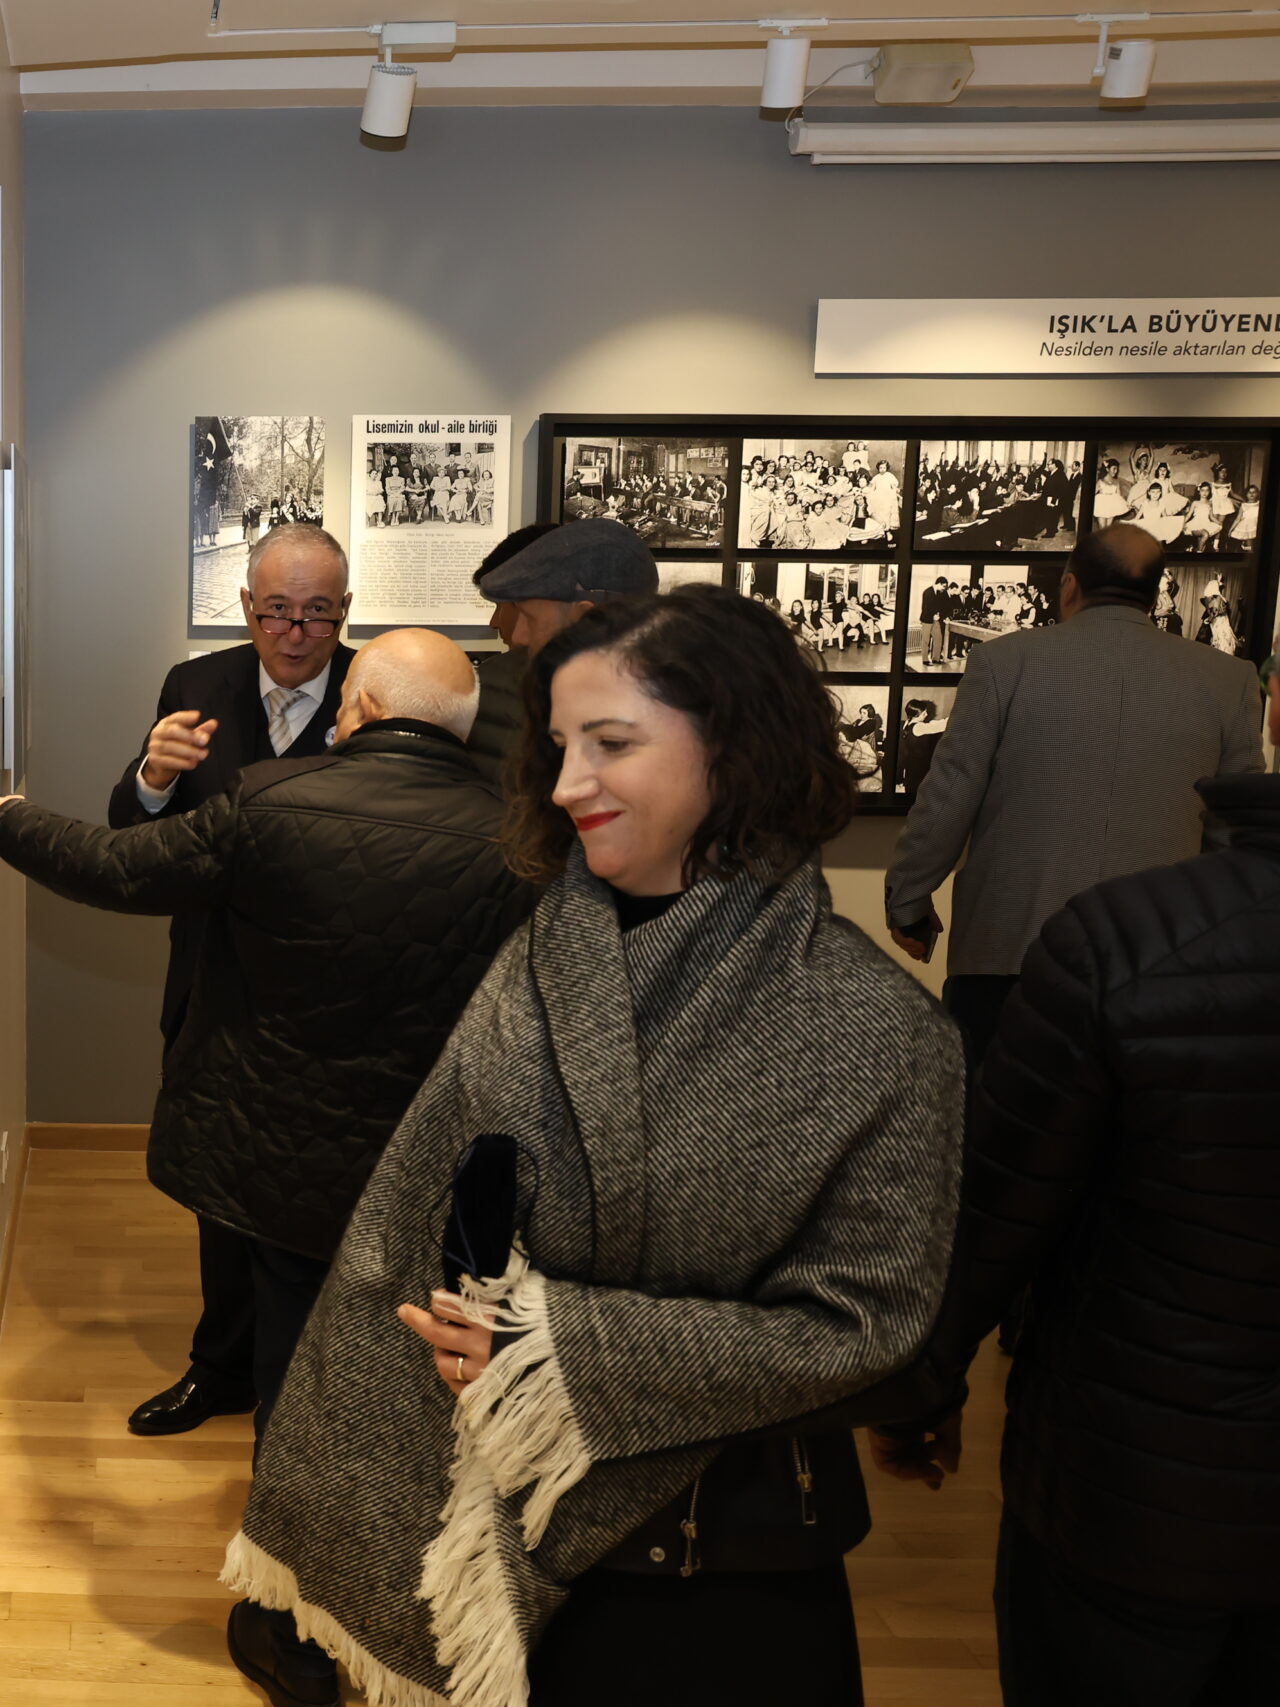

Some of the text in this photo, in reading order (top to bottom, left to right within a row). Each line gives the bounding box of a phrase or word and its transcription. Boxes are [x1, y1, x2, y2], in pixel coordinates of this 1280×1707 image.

[1040, 341, 1114, 356] Nesilden
[1119, 340, 1168, 356] nesile
[1172, 340, 1246, 355] aktarılan
[366, 419, 413, 433] Lisemizin
[418, 420, 439, 433] okul
[447, 420, 465, 433] aile
[468, 420, 498, 435] birliği
